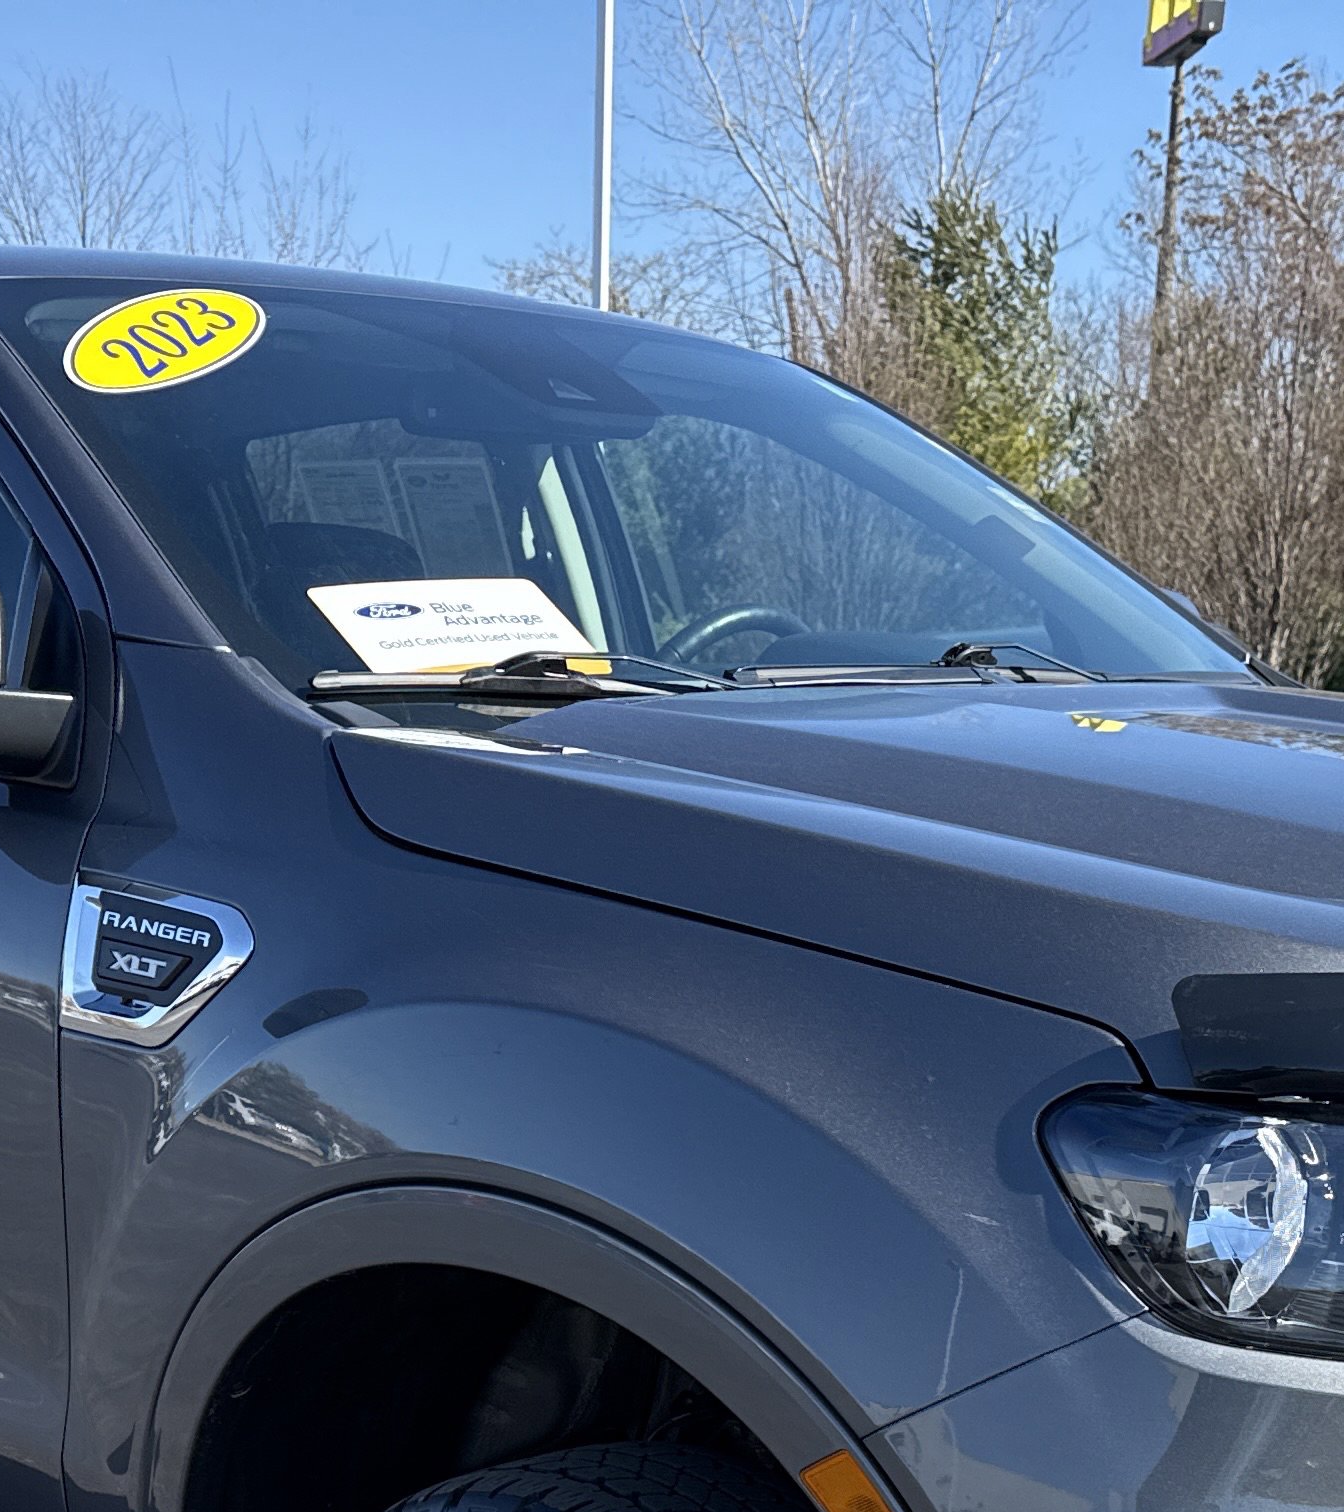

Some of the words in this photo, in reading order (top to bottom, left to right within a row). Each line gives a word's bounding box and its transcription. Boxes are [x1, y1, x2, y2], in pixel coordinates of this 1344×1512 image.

[102, 298, 236, 378] 2023
[429, 602, 474, 614] Blue
[444, 612, 544, 626] Advantage
[378, 637, 414, 650] Gold
[416, 634, 474, 647] Certified
[475, 632, 510, 643] Used
[512, 630, 560, 641] Vehicle
[102, 910, 211, 948] RANGER
[109, 950, 167, 979] XLT
